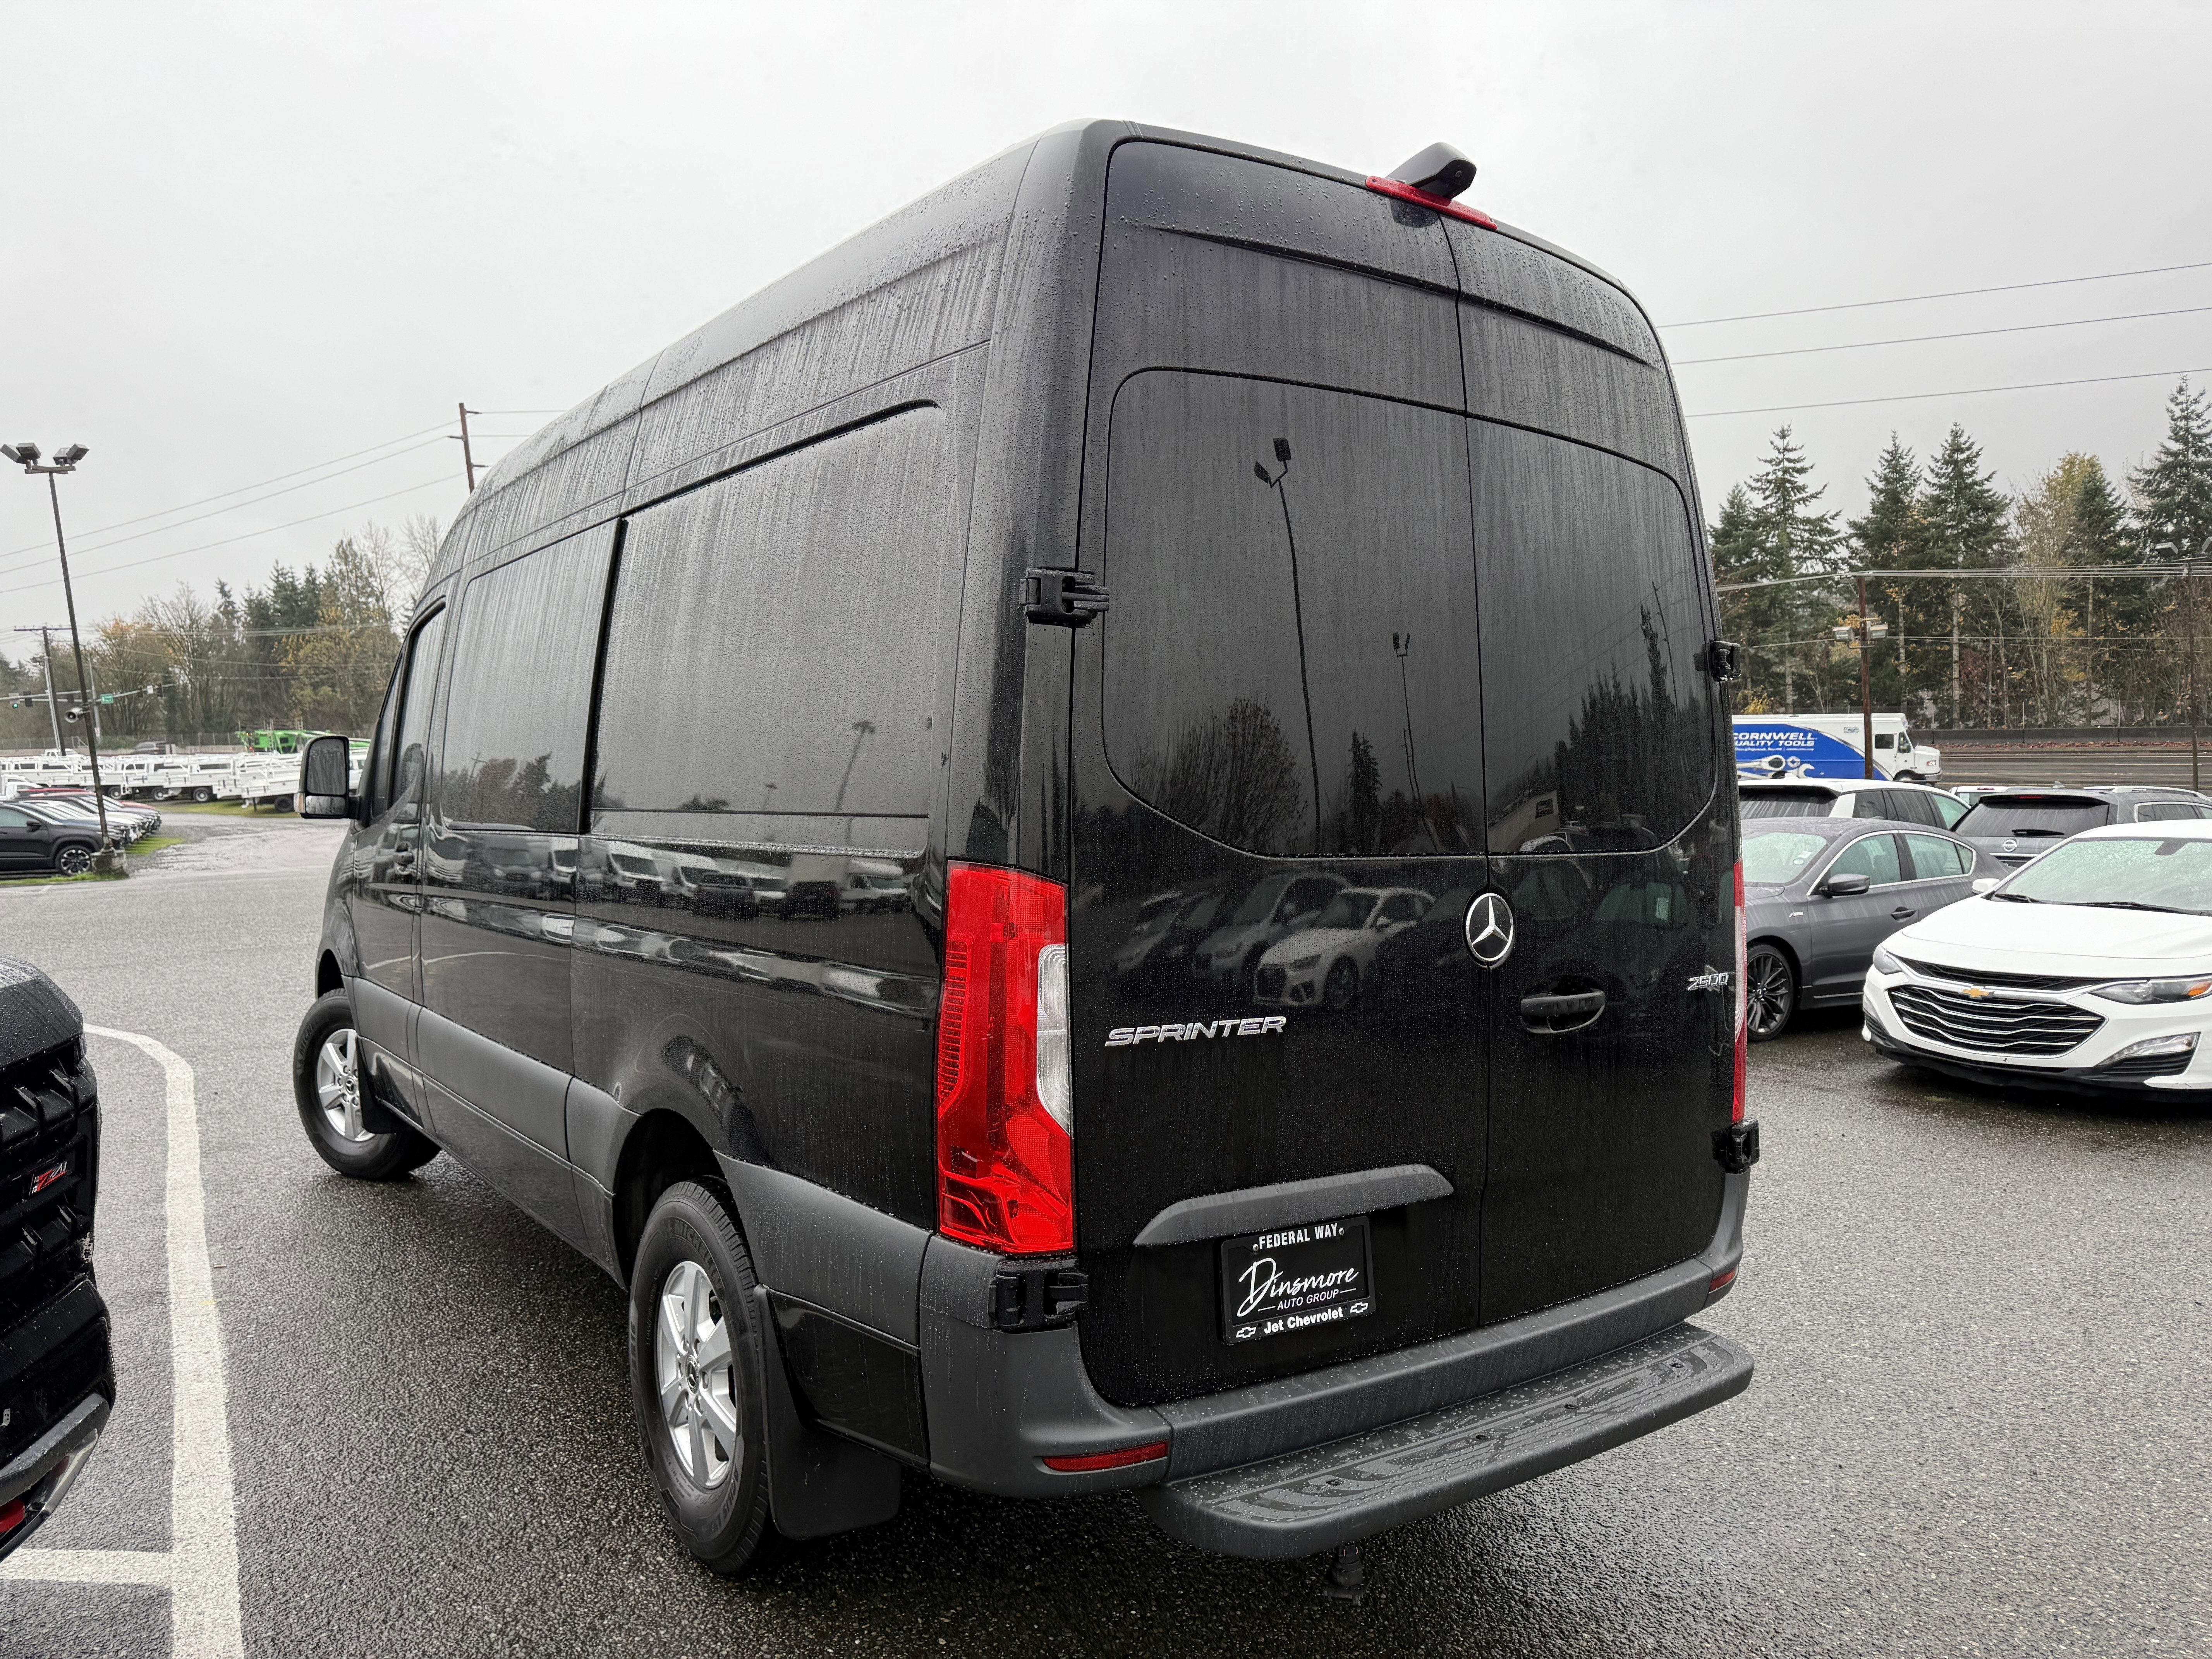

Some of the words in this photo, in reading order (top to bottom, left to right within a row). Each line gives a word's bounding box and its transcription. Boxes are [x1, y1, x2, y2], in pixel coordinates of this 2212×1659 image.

[1686, 972, 1729, 991] 2500
[1105, 1016, 1286, 1046] SPRINTER
[1259, 1229, 1310, 1250] FEDERAL
[1314, 1223, 1338, 1240] WAY
[674, 1219, 723, 1289] MICHELIN
[1237, 1258, 1359, 1317] Dinsmore
[1277, 1297, 1304, 1310] AUTO
[1306, 1289, 1339, 1304] GROUP
[1264, 1320, 1284, 1334] Jet
[1287, 1306, 1343, 1329] Chevrolet
